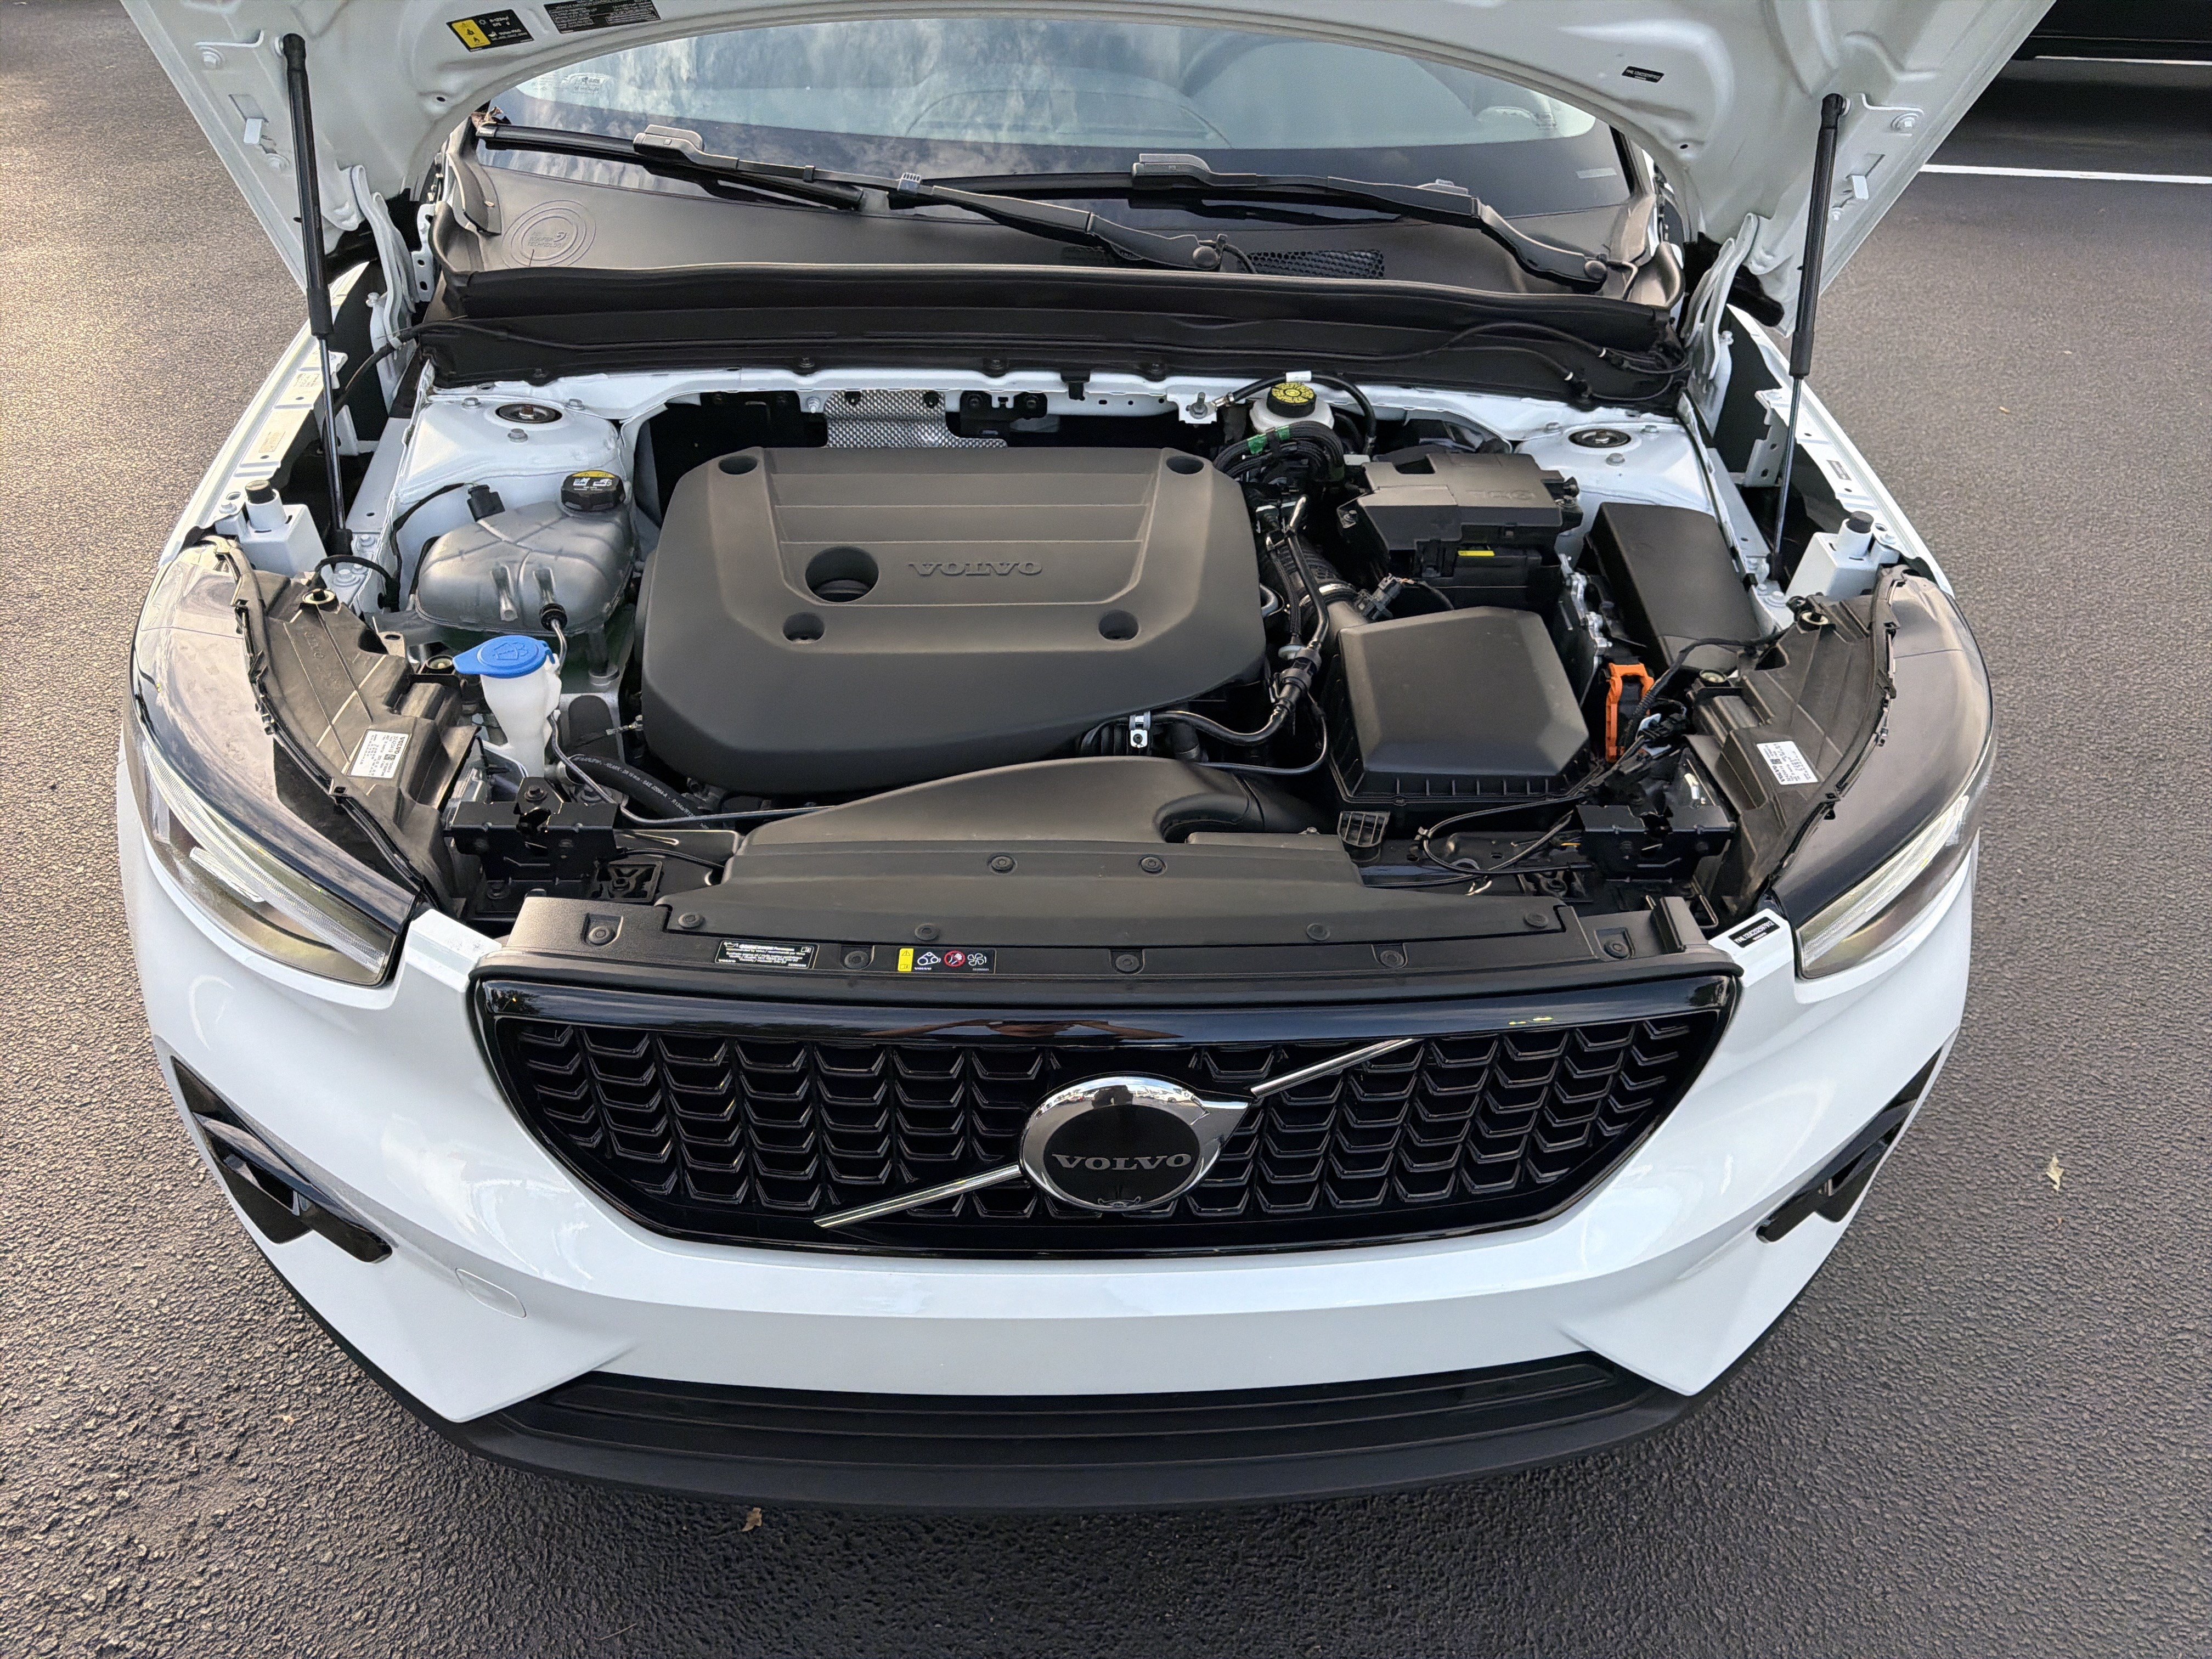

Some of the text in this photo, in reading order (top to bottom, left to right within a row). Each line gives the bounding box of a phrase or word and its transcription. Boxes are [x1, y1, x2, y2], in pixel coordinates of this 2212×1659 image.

[908, 562, 1043, 576] VOLVO
[394, 736, 406, 754] VOLVO
[1772, 765, 1786, 782] VOLVO
[1052, 1153, 1192, 1170] VOLVO
